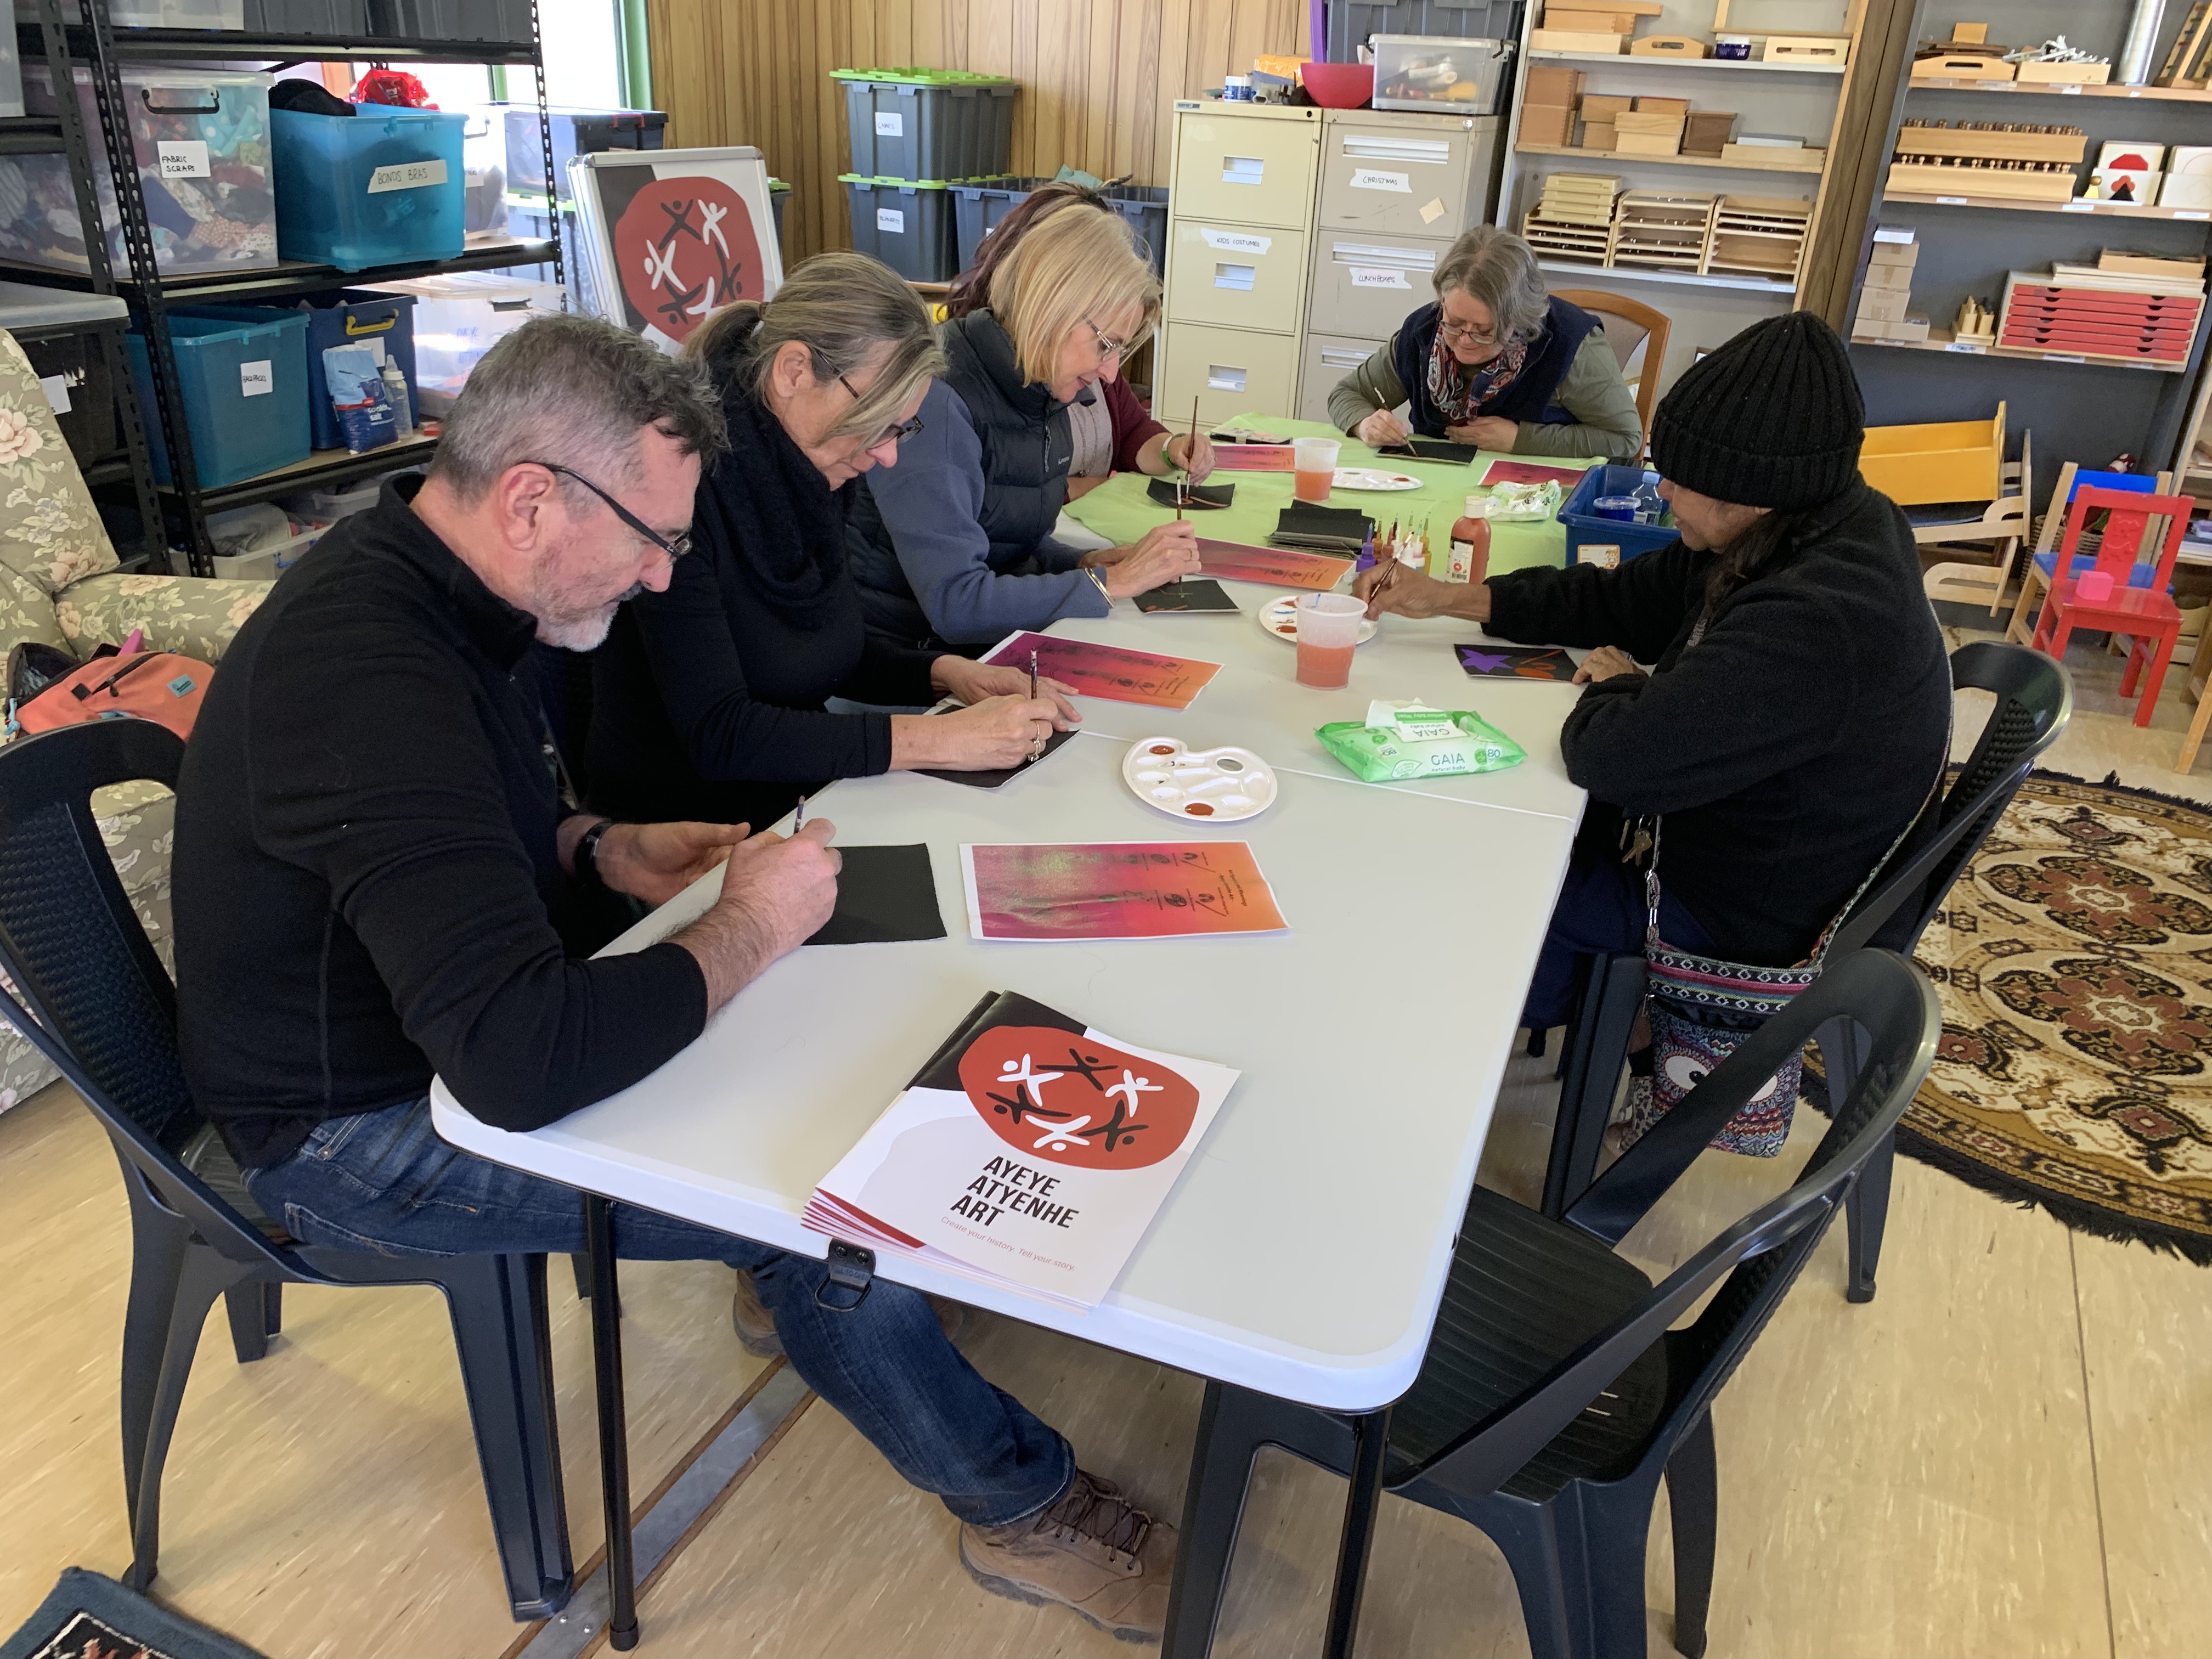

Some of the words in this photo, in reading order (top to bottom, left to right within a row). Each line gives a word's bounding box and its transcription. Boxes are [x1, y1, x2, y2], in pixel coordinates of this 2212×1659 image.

[162, 155, 187, 163] FABRIC
[378, 171, 402, 184] BONDS
[408, 168, 428, 180] BRAS
[1363, 176, 1397, 185] CHRISTMAS
[1412, 729, 1450, 737] GAIA
[1431, 753, 1465, 765] GAIA
[1487, 749, 1500, 758] 80
[983, 1155, 1060, 1197] AYEYE
[967, 1175, 1079, 1228] ATYENHE
[950, 1194, 1005, 1227] ART
[941, 1216, 967, 1233] Create
[968, 1229, 986, 1241] your
[986, 1235, 1015, 1252] history.
[1019, 1248, 1032, 1259] Tell
[1033, 1254, 1052, 1263] your
[1053, 1259, 1075, 1271] story.
